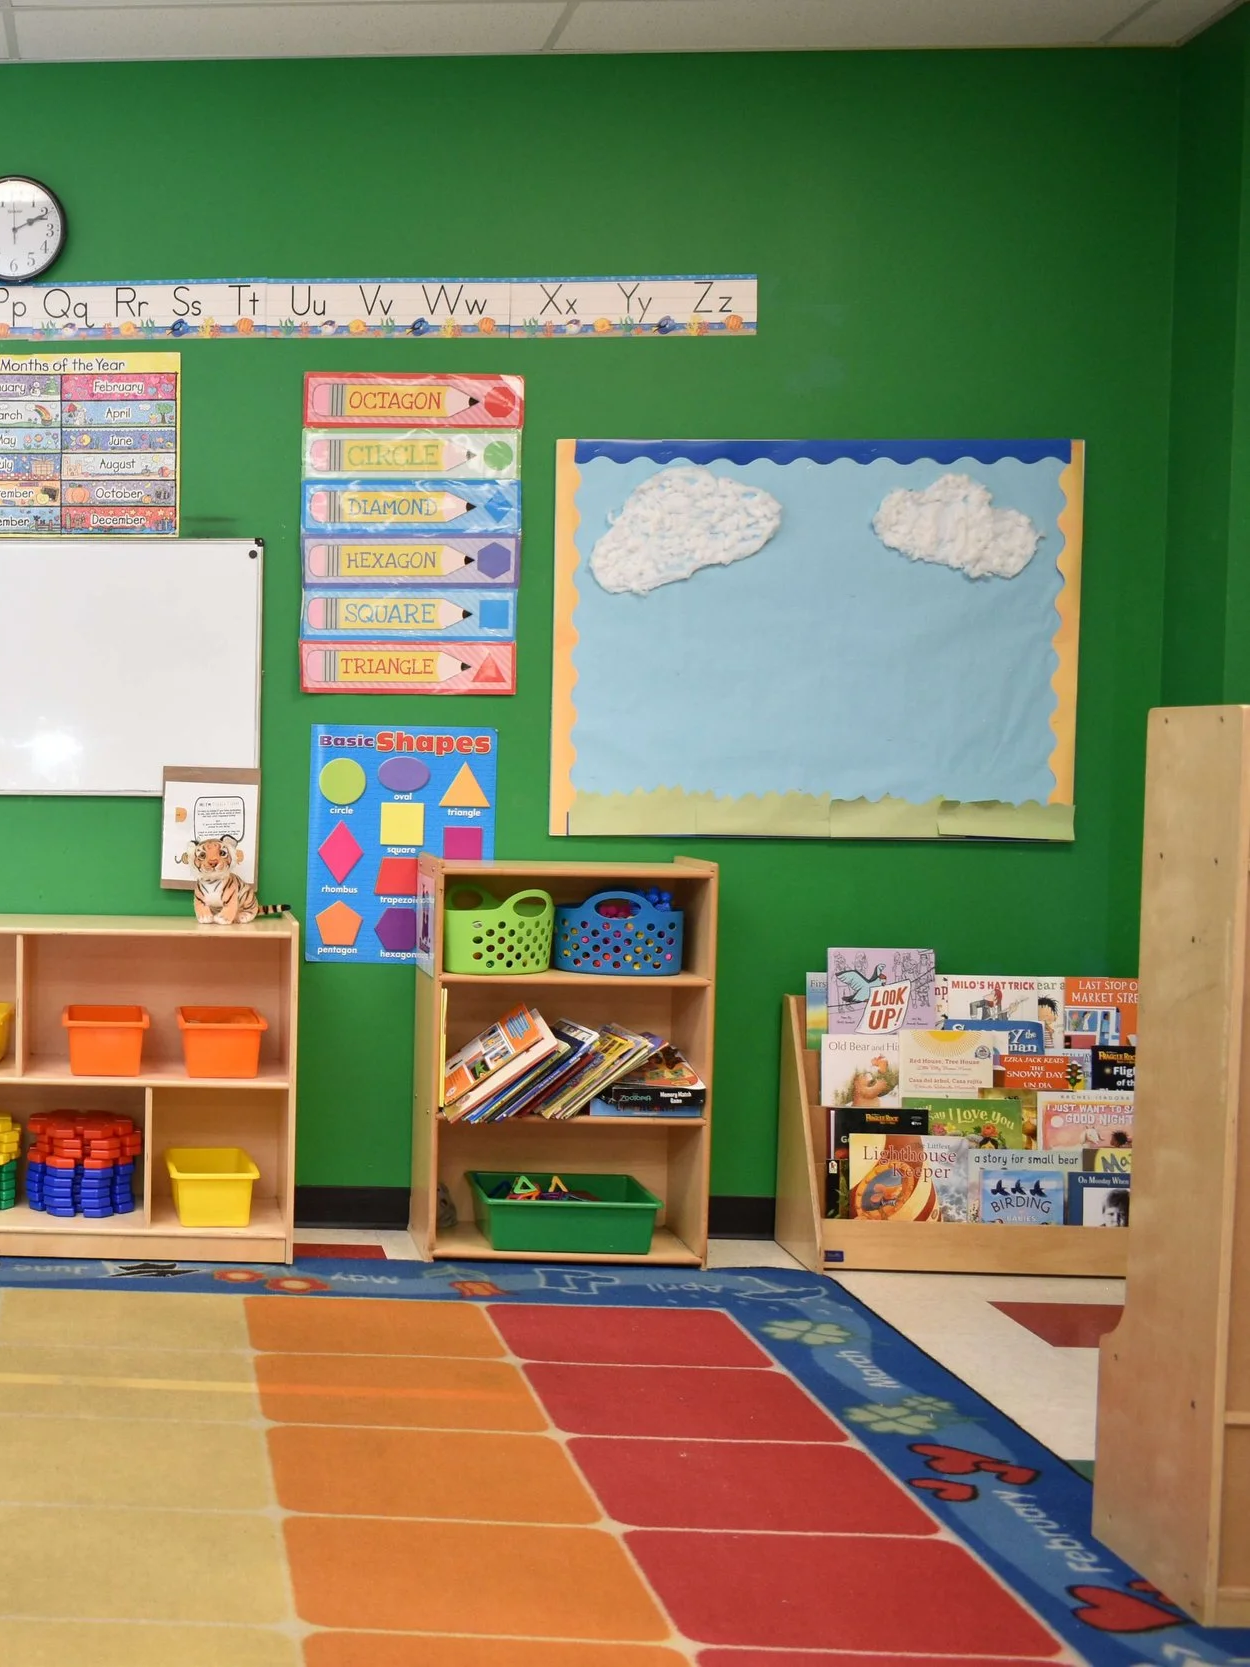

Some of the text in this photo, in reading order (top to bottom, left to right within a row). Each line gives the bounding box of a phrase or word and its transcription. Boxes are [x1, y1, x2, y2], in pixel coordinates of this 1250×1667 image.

[10, 259, 18, 273] 6
[43, 288, 95, 329] Qq
[115, 287, 149, 317] Rr
[172, 286, 202, 317] Ss
[228, 285, 259, 316] Tt
[291, 285, 326, 316] Uu
[359, 284, 393, 316] Vv
[421, 284, 487, 316] Ww
[540, 283, 577, 315] Xx
[617, 282, 652, 323] Yy
[693, 281, 733, 313] Zz
[0, 358, 125, 372] Months of the Year
[94, 381, 144, 394] February
[349, 391, 442, 410] OCTAGON
[106, 408, 131, 421] April
[109, 435, 132, 446] June
[347, 444, 439, 467] CIRCLE
[99, 459, 136, 473] August
[95, 488, 143, 499] October
[348, 498, 438, 517] DIAMOND
[91, 515, 146, 526] December
[346, 551, 437, 569] HEXAGON
[344, 603, 436, 624] SQUARE
[341, 658, 434, 676] TRIANGLE
[318, 731, 491, 756] Basic Shapes
[394, 793, 413, 801] oval
[329, 806, 354, 815] circle
[447, 808, 481, 818] triangle
[387, 846, 416, 855] square
[321, 885, 358, 894] rhombus
[317, 946, 358, 955] pentagon
[951, 980, 1035, 991] MILO'S HAT TRICK
[1079, 981, 1127, 991] LAST STOP
[870, 986, 908, 1007] LOOK
[1071, 992, 1113, 1003] MARKET
[868, 1008, 903, 1030] UP!
[828, 1041, 885, 1051] Old Bear and
[1052, 1104, 1121, 1113] JUST WANT TO
[957, 1108, 988, 1124] Love
[1065, 1114, 1134, 1126] GOOD NIGHT
[863, 1145, 957, 1165] Lighthouse
[983, 1154, 1007, 1166] story
[1011, 1154, 1024, 1164] for
[1028, 1154, 1054, 1164] small
[1058, 1155, 1079, 1165] bear
[892, 1164, 951, 1182] Keeper
[1078, 1176, 1111, 1186] On Monday
[990, 1195, 1052, 1214] BIRDING
[646, 1282, 725, 1294] April
[835, 1350, 901, 1389] March
[991, 1489, 1114, 1574] February
